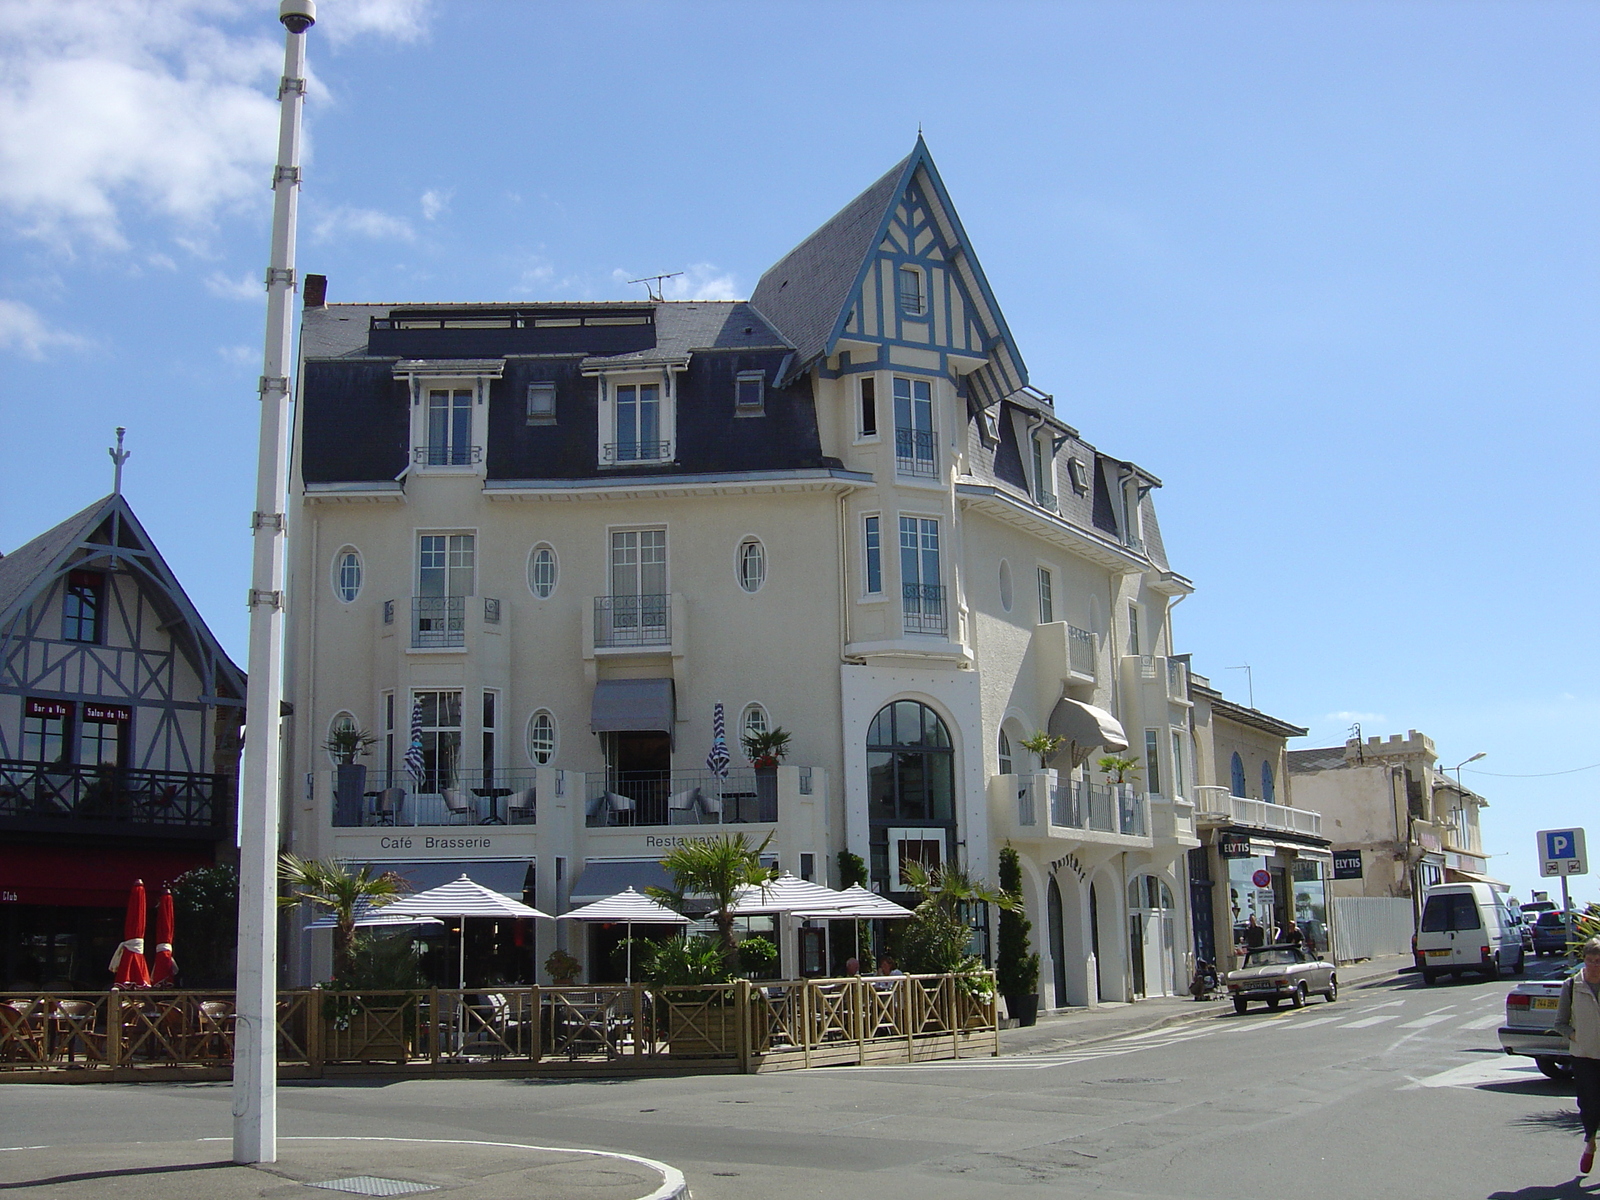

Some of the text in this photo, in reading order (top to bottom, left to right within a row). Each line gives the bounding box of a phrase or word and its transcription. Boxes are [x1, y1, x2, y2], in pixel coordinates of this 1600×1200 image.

[33, 702, 45, 713] Bar
[56, 704, 66, 714] Vin
[87, 707, 104, 718] Salon
[106, 709, 115, 719] de
[380, 836, 491, 849] Café Brasserie
[1223, 842, 1250, 853] ELYTIS
[1553, 835, 1568, 855] P
[1335, 858, 1361, 869] ELYTIS
[2, 890, 18, 901] Club
